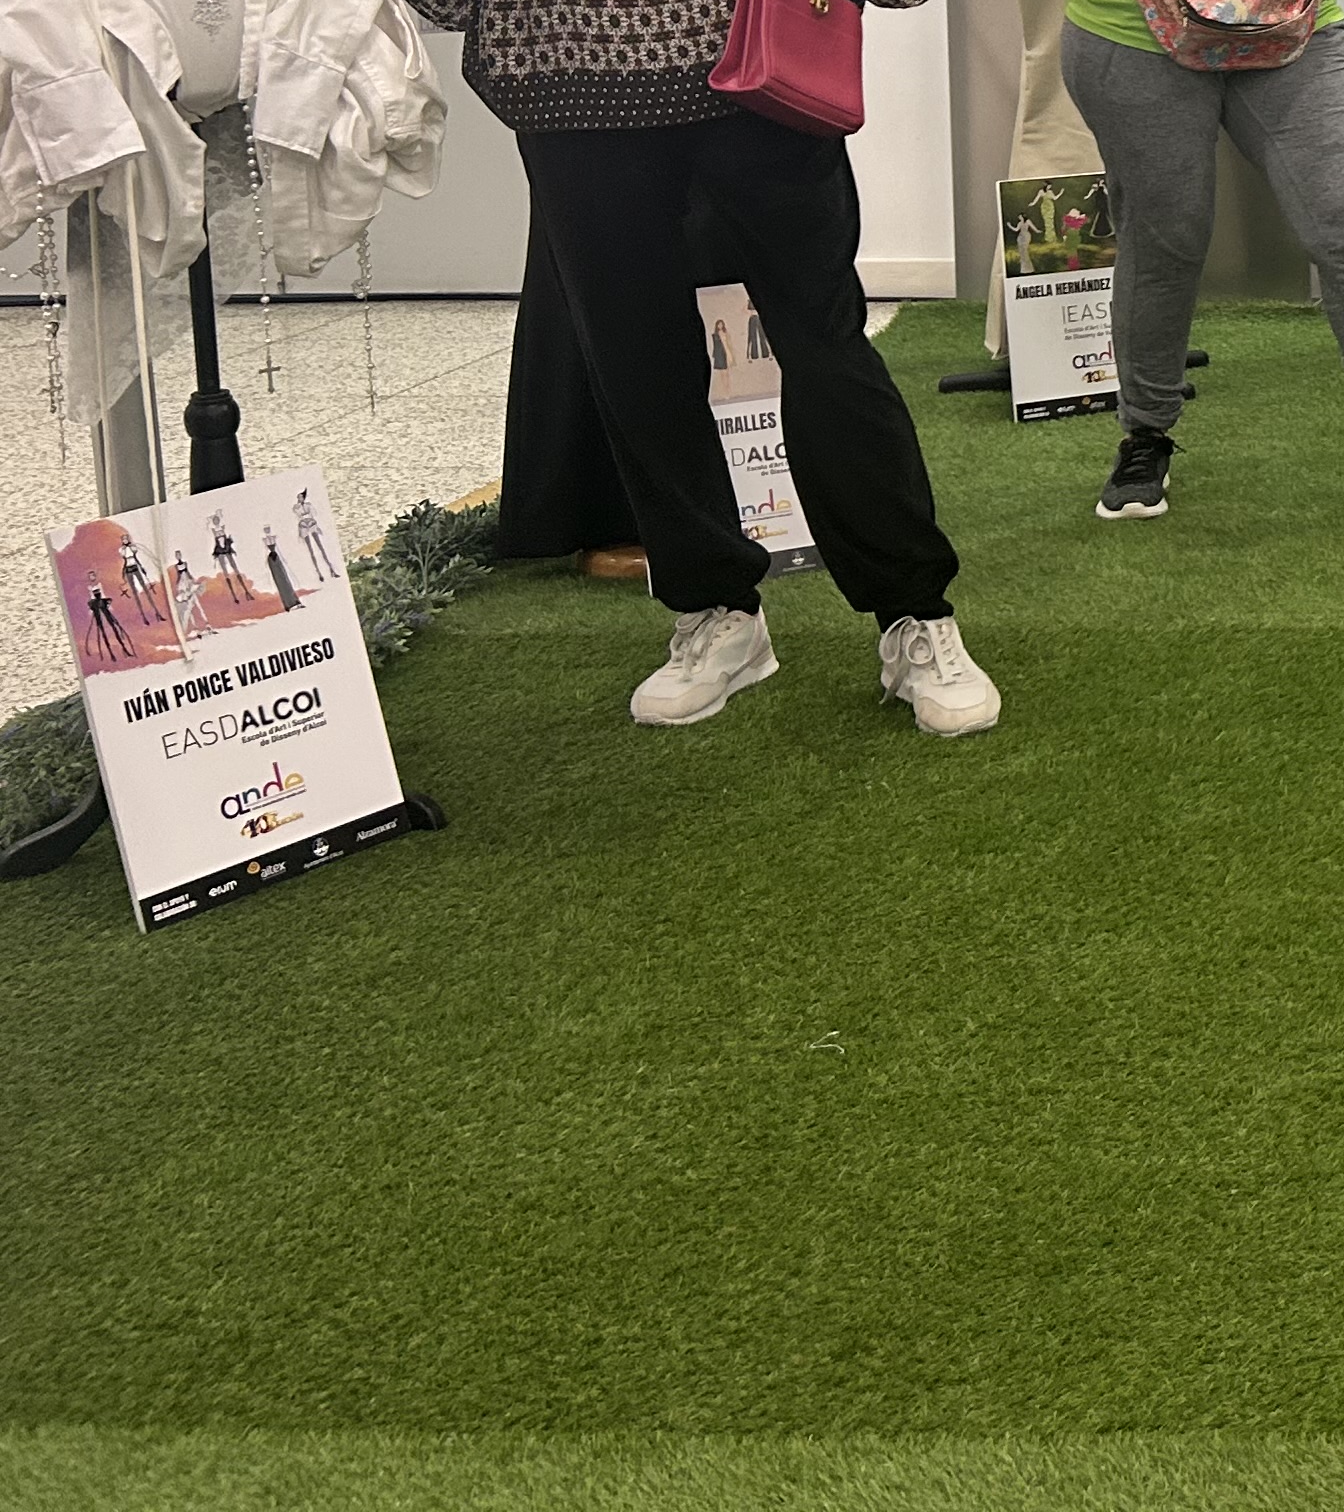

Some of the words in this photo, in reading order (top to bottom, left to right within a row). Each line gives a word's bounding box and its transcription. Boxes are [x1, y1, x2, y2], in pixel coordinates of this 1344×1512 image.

[1015, 282, 1053, 301] ÁNGELA
[1056, 277, 1112, 297] HERNÁNDEZ
[716, 411, 777, 435] IRALLES
[124, 689, 170, 724] IVÁN
[173, 668, 234, 709] PONCE
[236, 636, 335, 688] VALDIVIESO
[161, 687, 322, 760] EASDALCOI
[220, 761, 305, 819] ande
